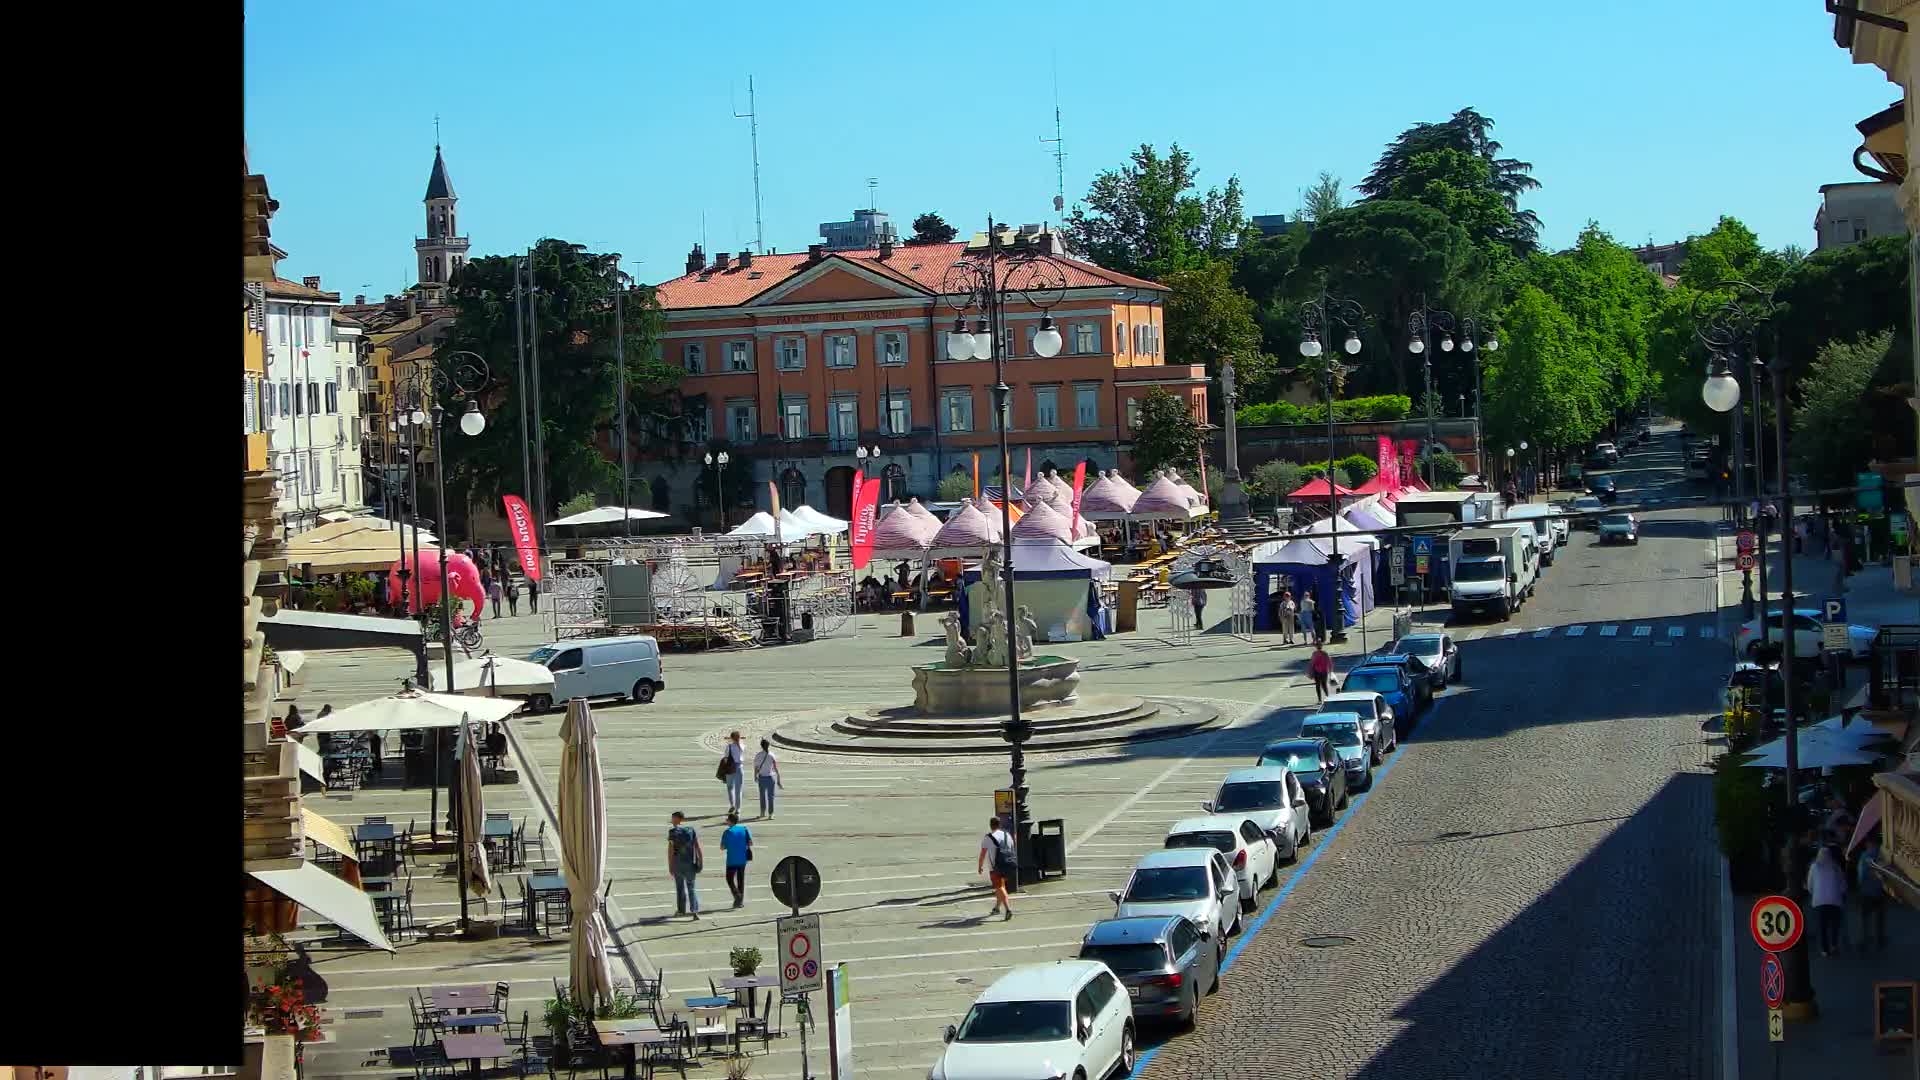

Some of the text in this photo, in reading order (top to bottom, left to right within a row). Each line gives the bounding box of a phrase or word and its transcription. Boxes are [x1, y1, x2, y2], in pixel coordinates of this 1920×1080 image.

[854, 507, 869, 544] Tipico
[1741, 556, 1752, 566] 20
[1826, 601, 1841, 621] P
[1761, 910, 1791, 937] 30
[788, 967, 797, 977] 10
